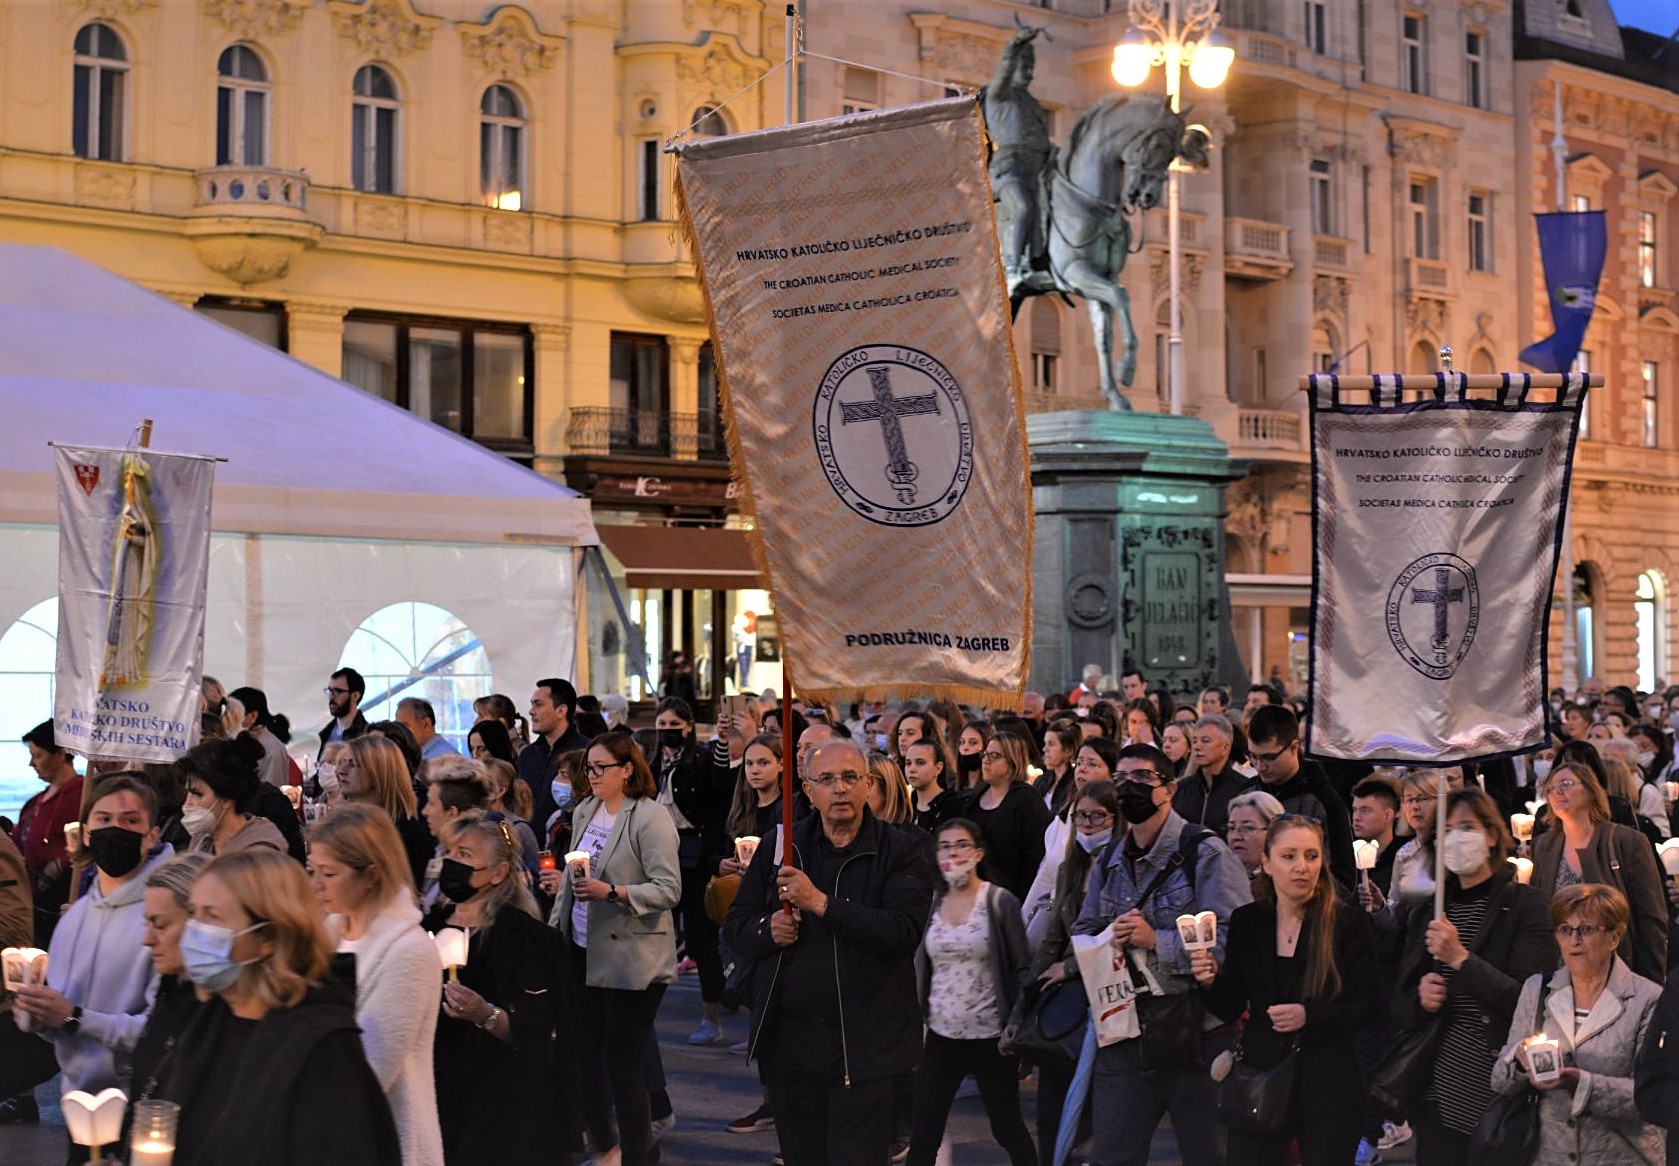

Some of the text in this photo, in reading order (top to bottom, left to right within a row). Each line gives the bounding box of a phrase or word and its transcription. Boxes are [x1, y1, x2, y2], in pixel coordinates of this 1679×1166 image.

[736, 248, 788, 261] HRVATSKO
[791, 239, 850, 258] KATOLIČKO
[852, 228, 922, 250] LIJEČNIČKO
[763, 279, 778, 290] THE
[779, 275, 827, 290] CROATIAN
[829, 269, 876, 284] CATHOLIC
[878, 261, 923, 278] MEDICAL
[772, 304, 816, 319] SOCIETAS
[817, 300, 851, 314] MEDICA
[853, 292, 912, 311] CATHOLICA
[1336, 448, 1390, 460] HRVATSKO
[1393, 445, 1451, 459] KATOLIČKO
[1356, 474, 1372, 484] THE
[1373, 474, 1420, 484] CROATIAN
[1422, 474, 1463, 484] CATHOLIC
[1358, 499, 1401, 508] SOCIETAS
[1403, 499, 1436, 508] MEDICA
[884, 507, 939, 523] ZAGREB
[845, 628, 1010, 652] PODRUŽNICA ZAGREB
[120, 715, 185, 734] DRUŠTVO
[126, 732, 187, 751] SESTARA
